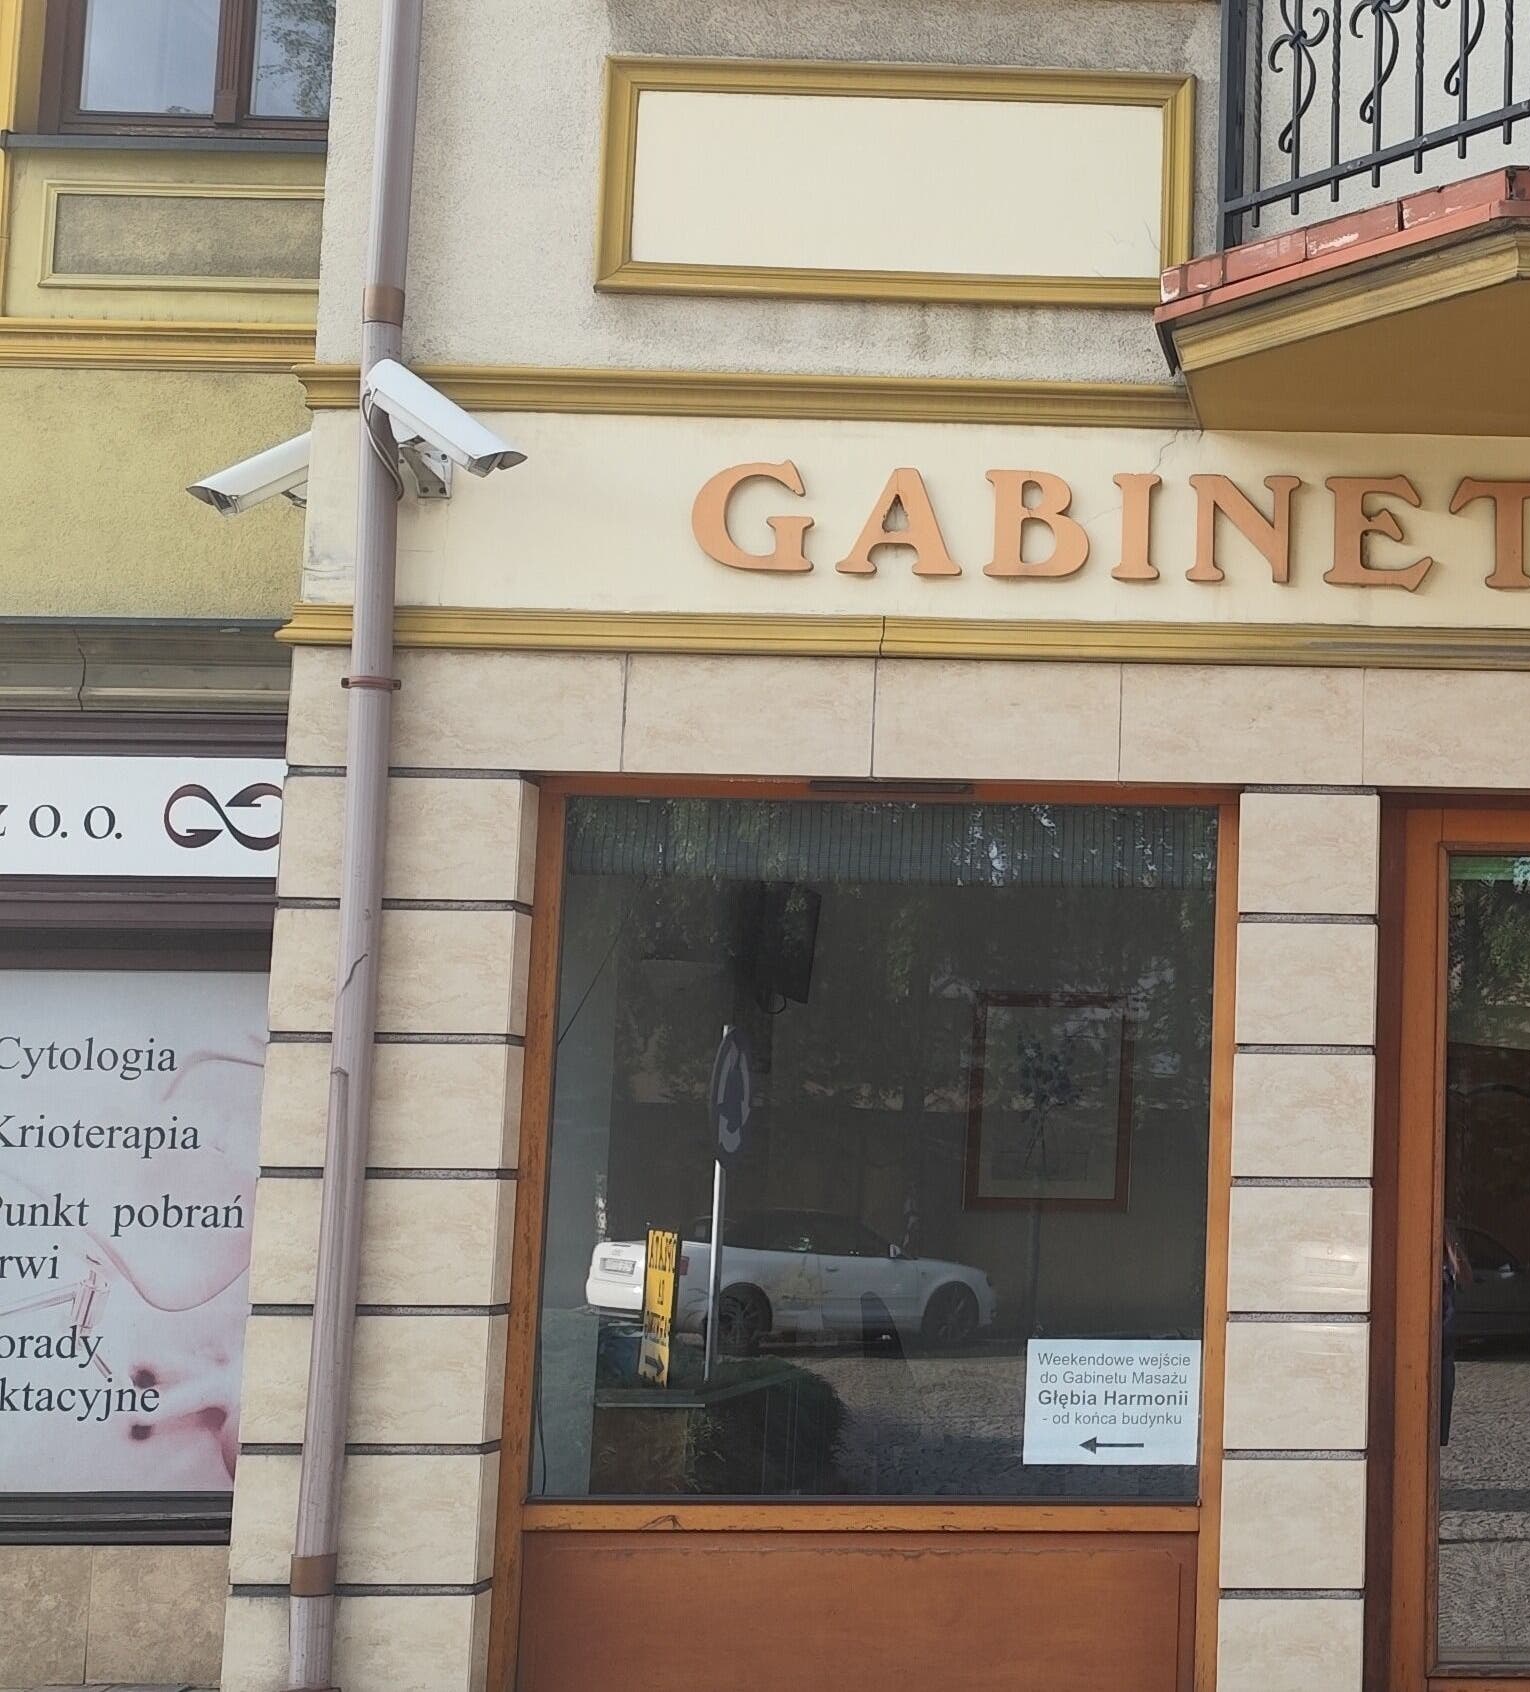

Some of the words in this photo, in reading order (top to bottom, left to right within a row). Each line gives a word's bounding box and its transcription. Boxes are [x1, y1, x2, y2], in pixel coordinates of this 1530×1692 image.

[0, 1036, 178, 1081] Cytologia
[0, 1192, 90, 1227] unkt
[111, 1193, 244, 1238] pobrań
[1037, 1352, 1135, 1367] Weekendowe
[1138, 1352, 1192, 1370] wejście
[1039, 1371, 1058, 1385] do
[1062, 1370, 1127, 1385] Gabinetu
[1131, 1371, 1188, 1385] Masażu
[1037, 1389, 1098, 1410] Głębia
[1103, 1389, 1189, 1407] Harmonii
[1052, 1412, 1070, 1425] od
[1074, 1411, 1117, 1425] końca
[1121, 1412, 1182, 1429] budynku
